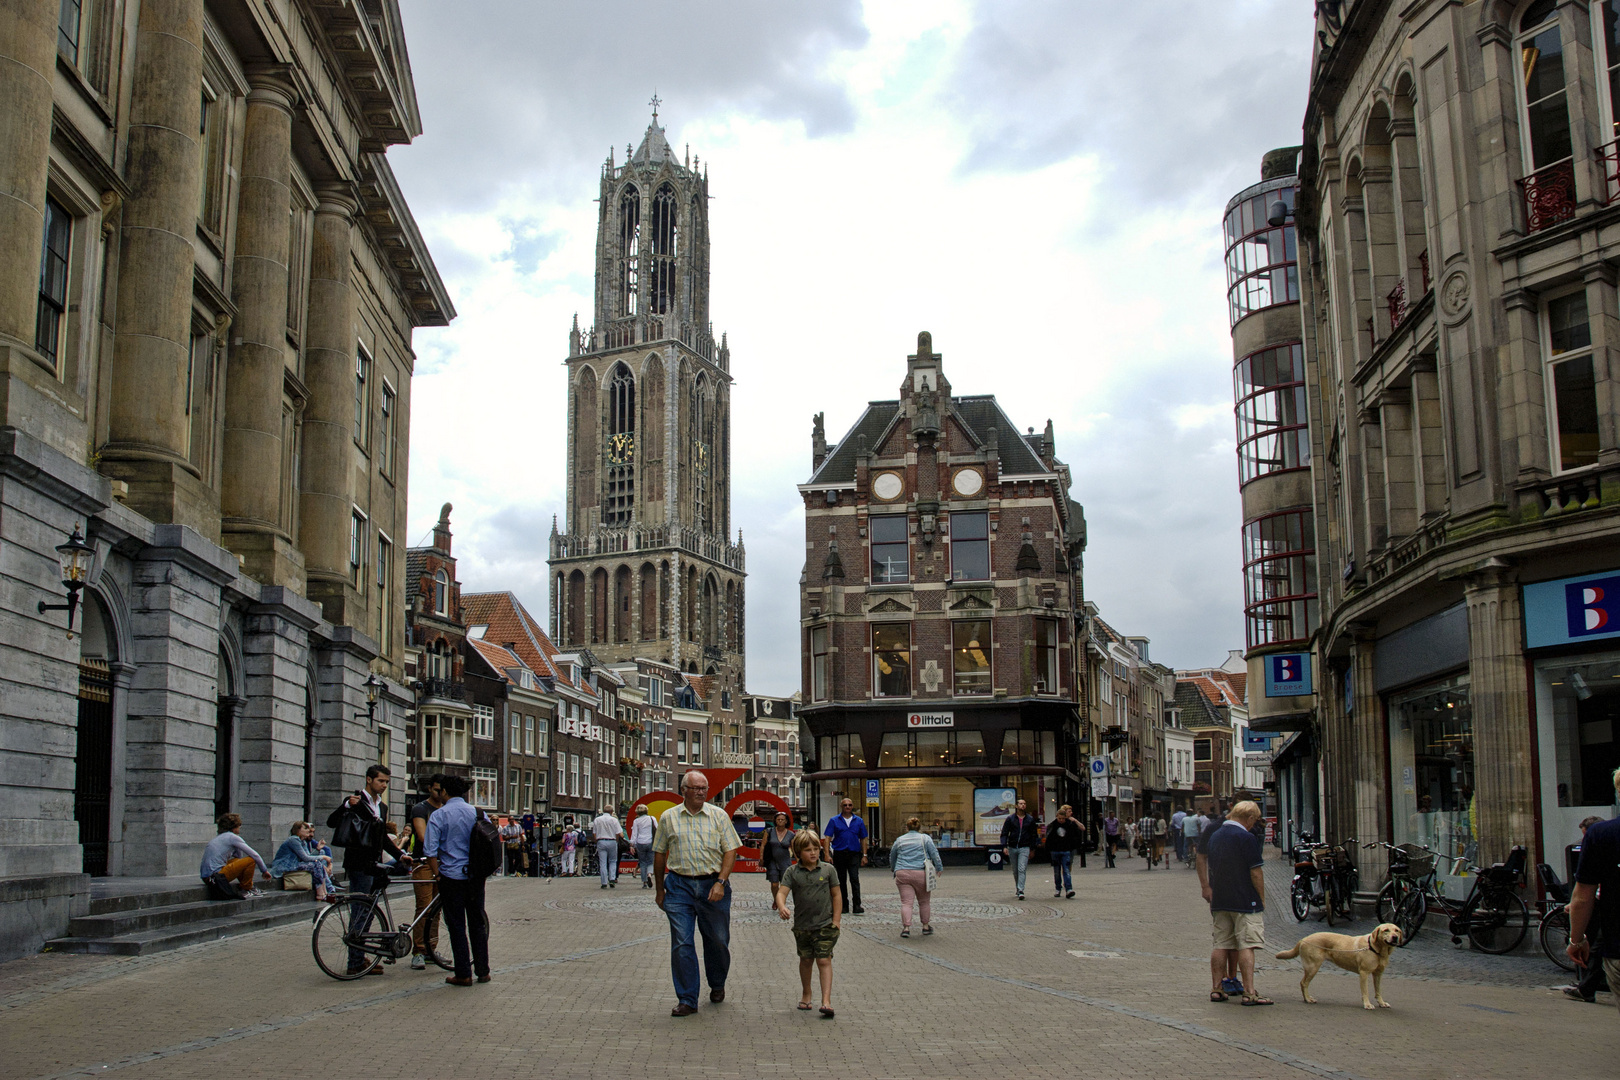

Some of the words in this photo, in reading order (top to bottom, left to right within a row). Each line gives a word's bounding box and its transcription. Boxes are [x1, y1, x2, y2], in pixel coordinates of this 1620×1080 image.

[1583, 587, 1608, 630] B
[1282, 659, 1294, 680] B
[869, 781, 877, 791] P
